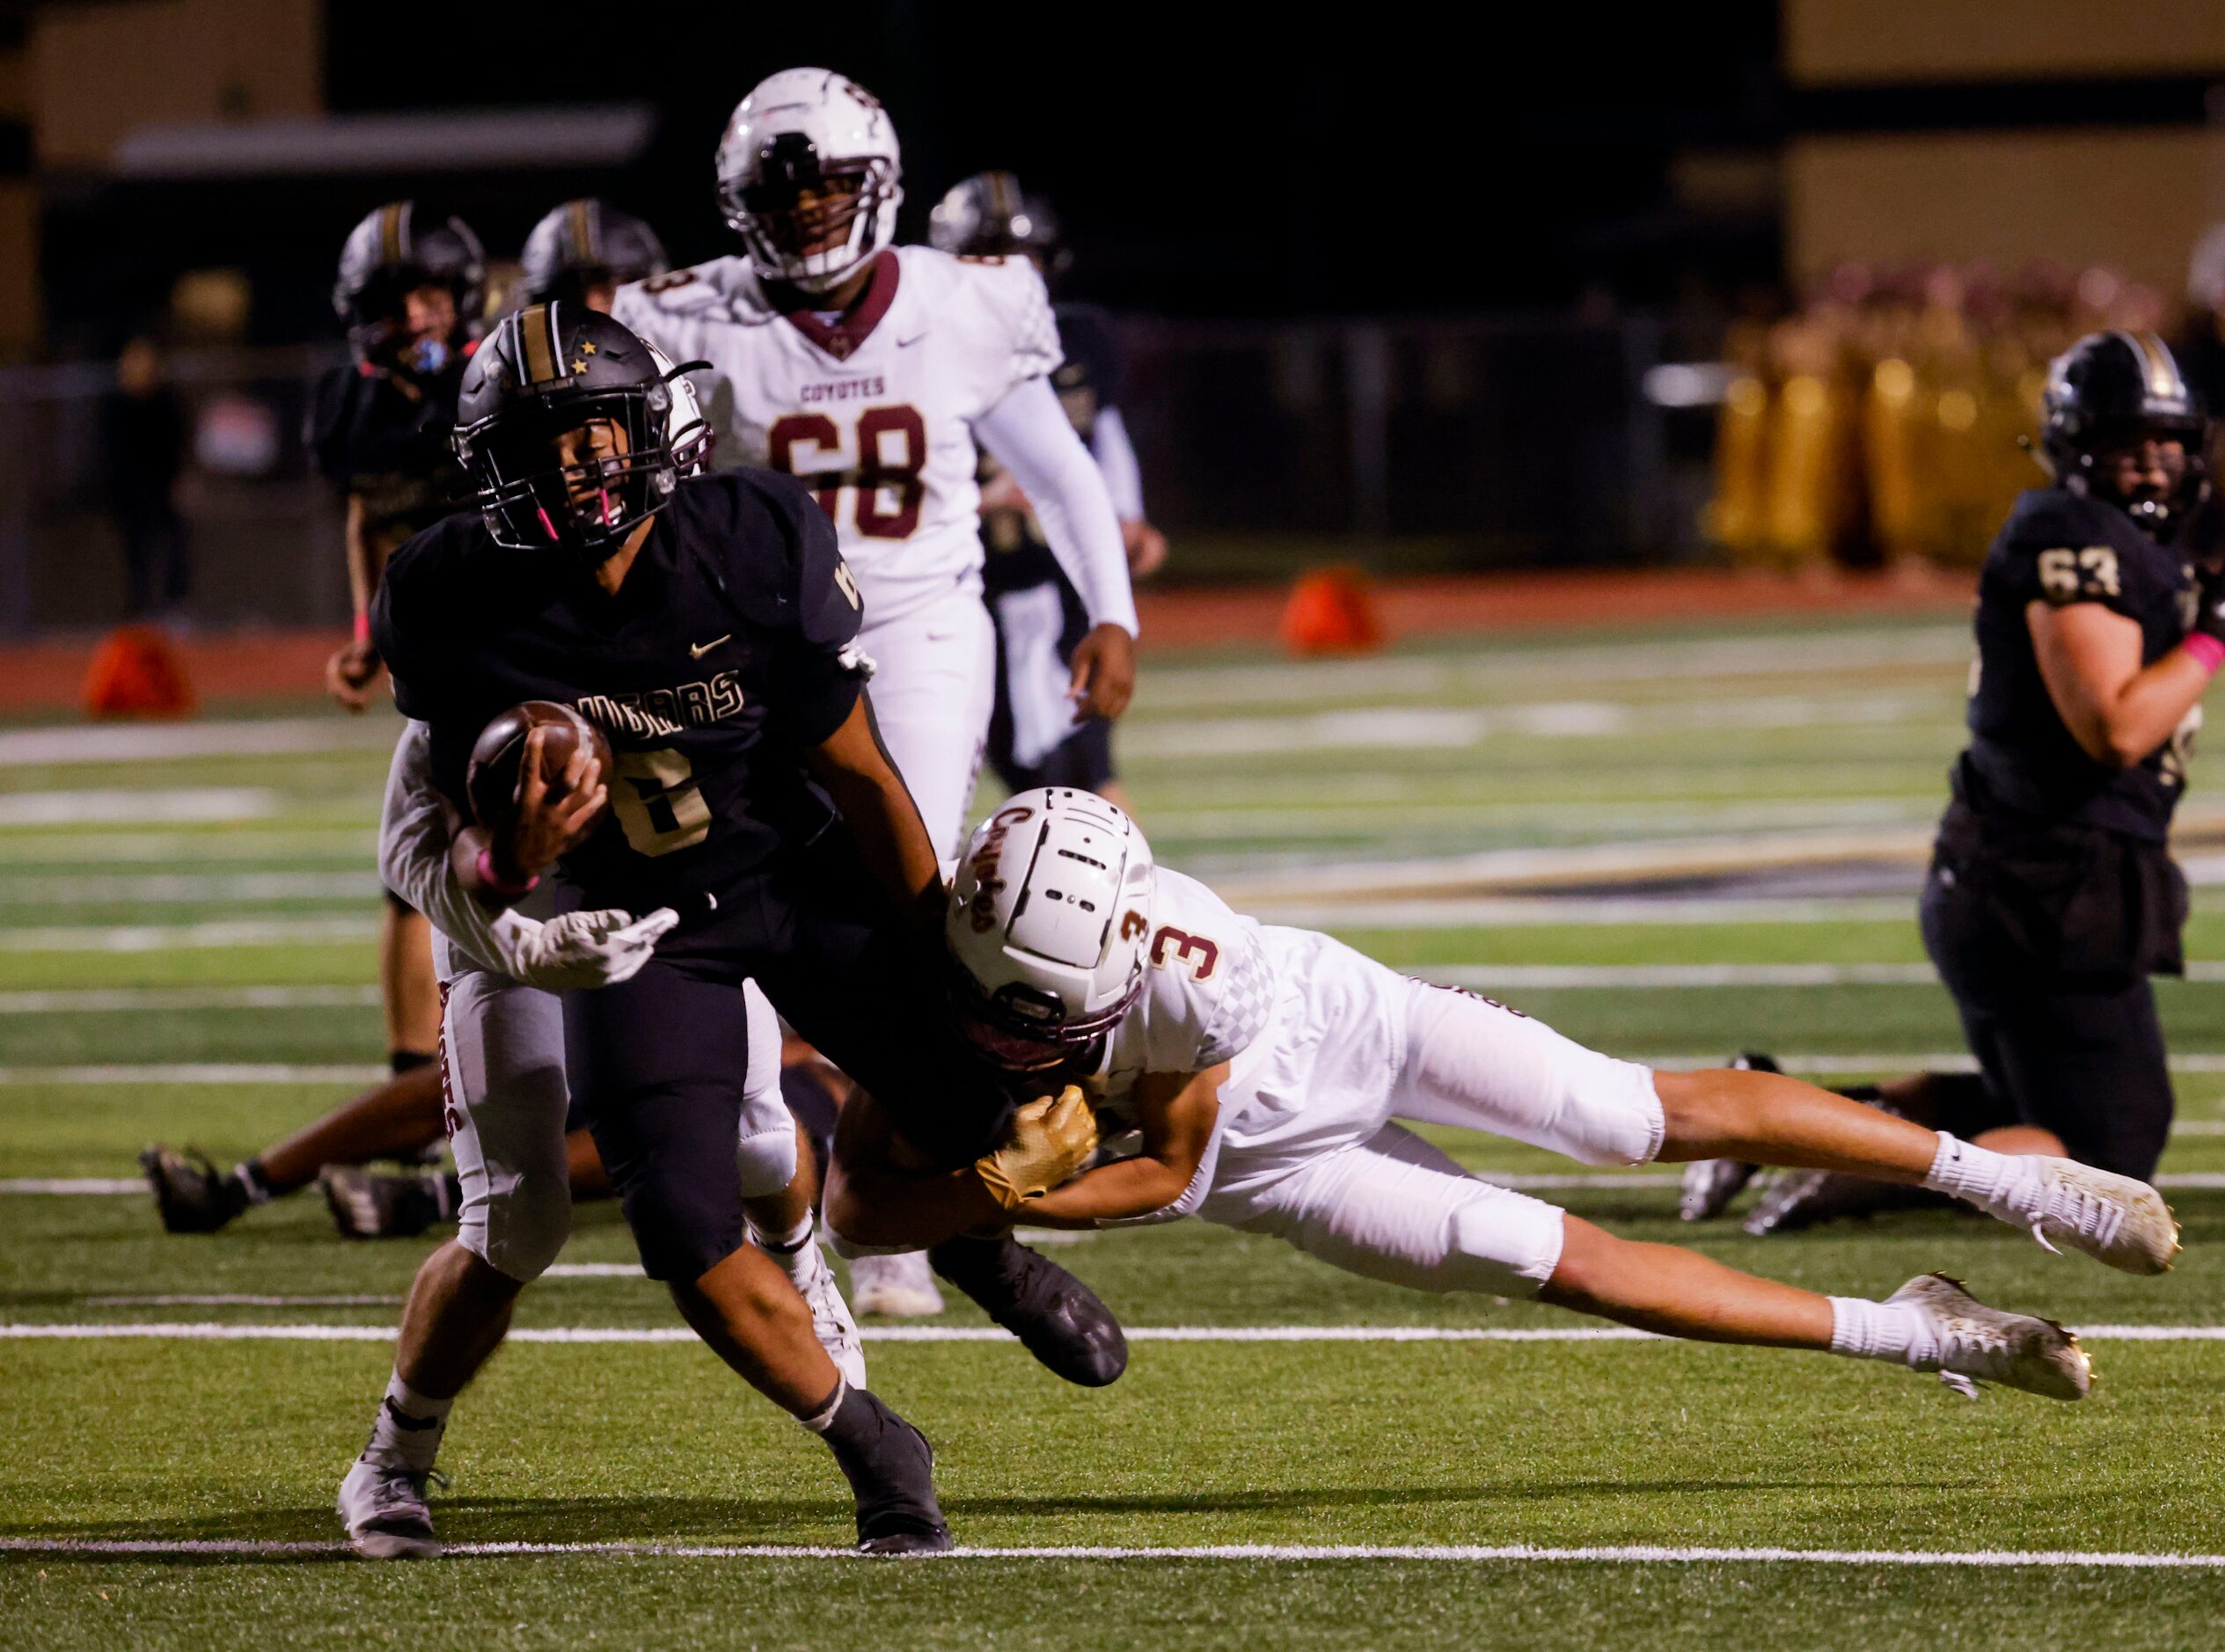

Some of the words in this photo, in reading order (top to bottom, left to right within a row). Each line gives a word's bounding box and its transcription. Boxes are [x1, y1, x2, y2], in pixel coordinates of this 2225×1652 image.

[801, 376, 885, 404] COYOTES
[769, 402, 926, 541] 68
[2037, 546, 2122, 600] 63
[1120, 908, 1149, 944] 3
[1149, 923, 1223, 985] 3
